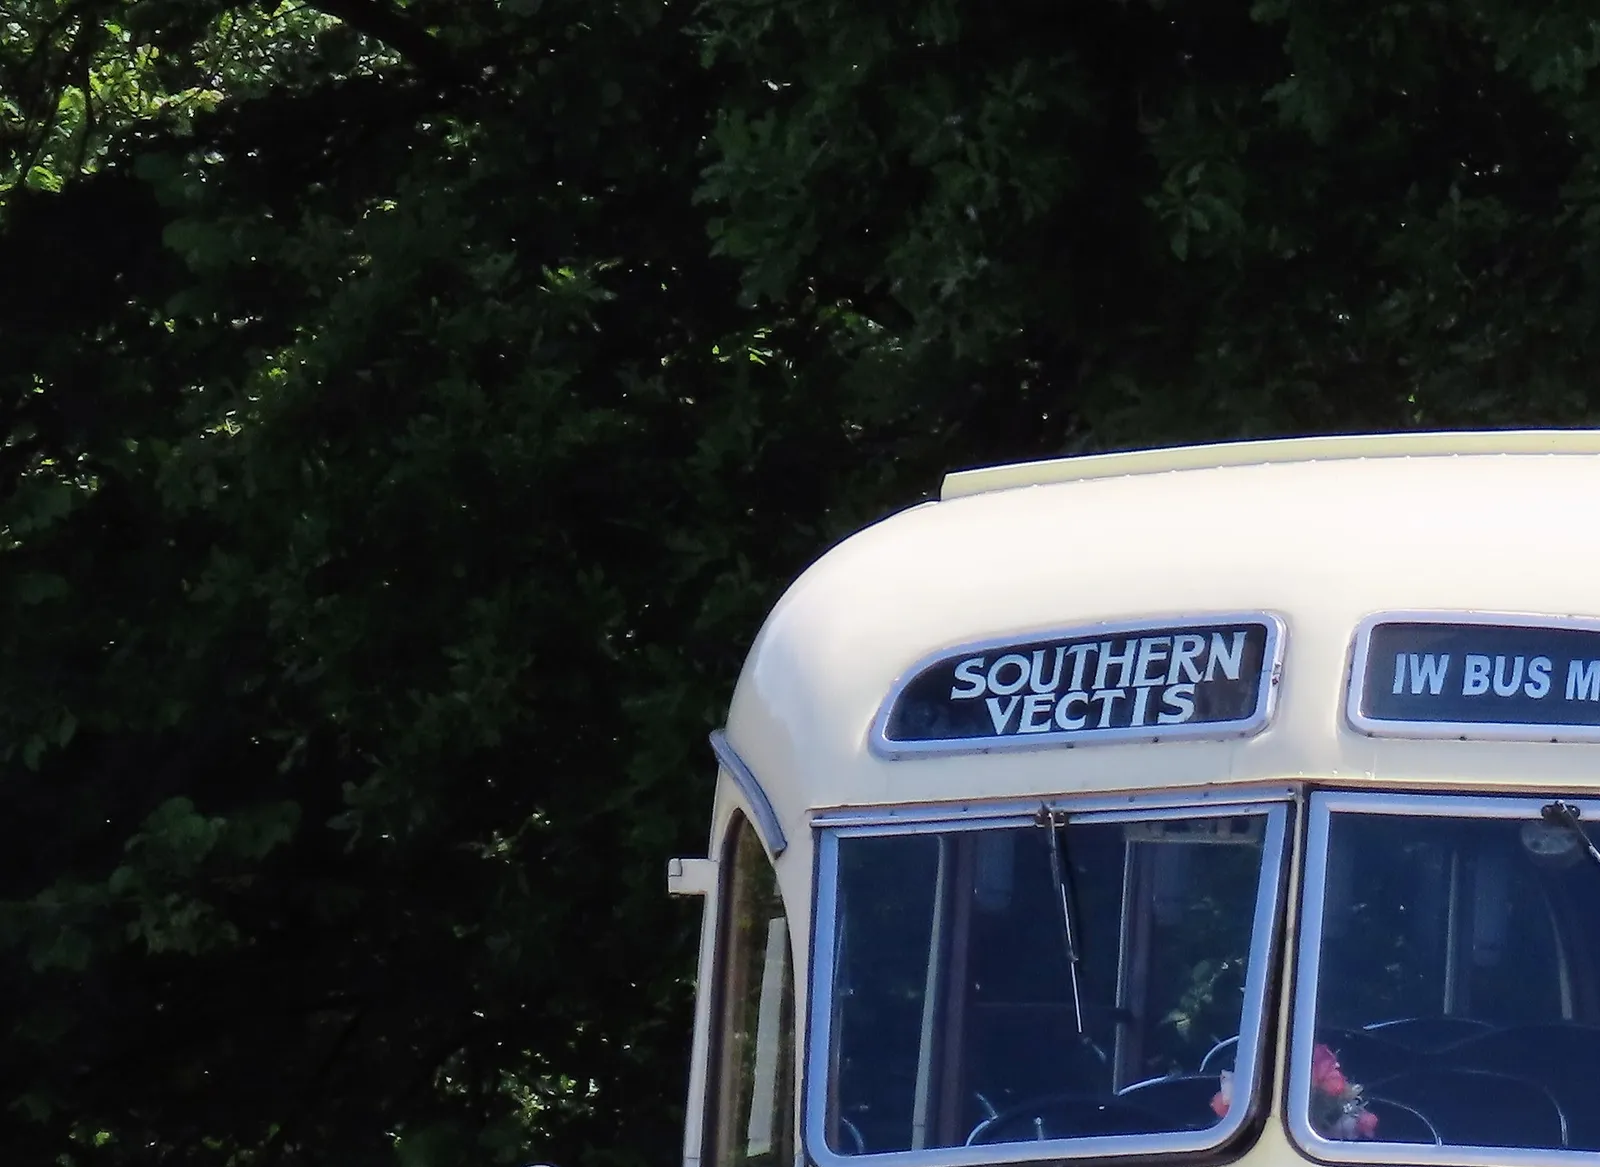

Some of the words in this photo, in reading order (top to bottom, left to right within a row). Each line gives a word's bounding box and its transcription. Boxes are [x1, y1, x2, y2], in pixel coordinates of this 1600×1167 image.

[950, 631, 1247, 700] SOUTHERN
[1392, 653, 1449, 695] IW
[1462, 653, 1552, 698] BUS
[985, 683, 1195, 735] VECTIS
